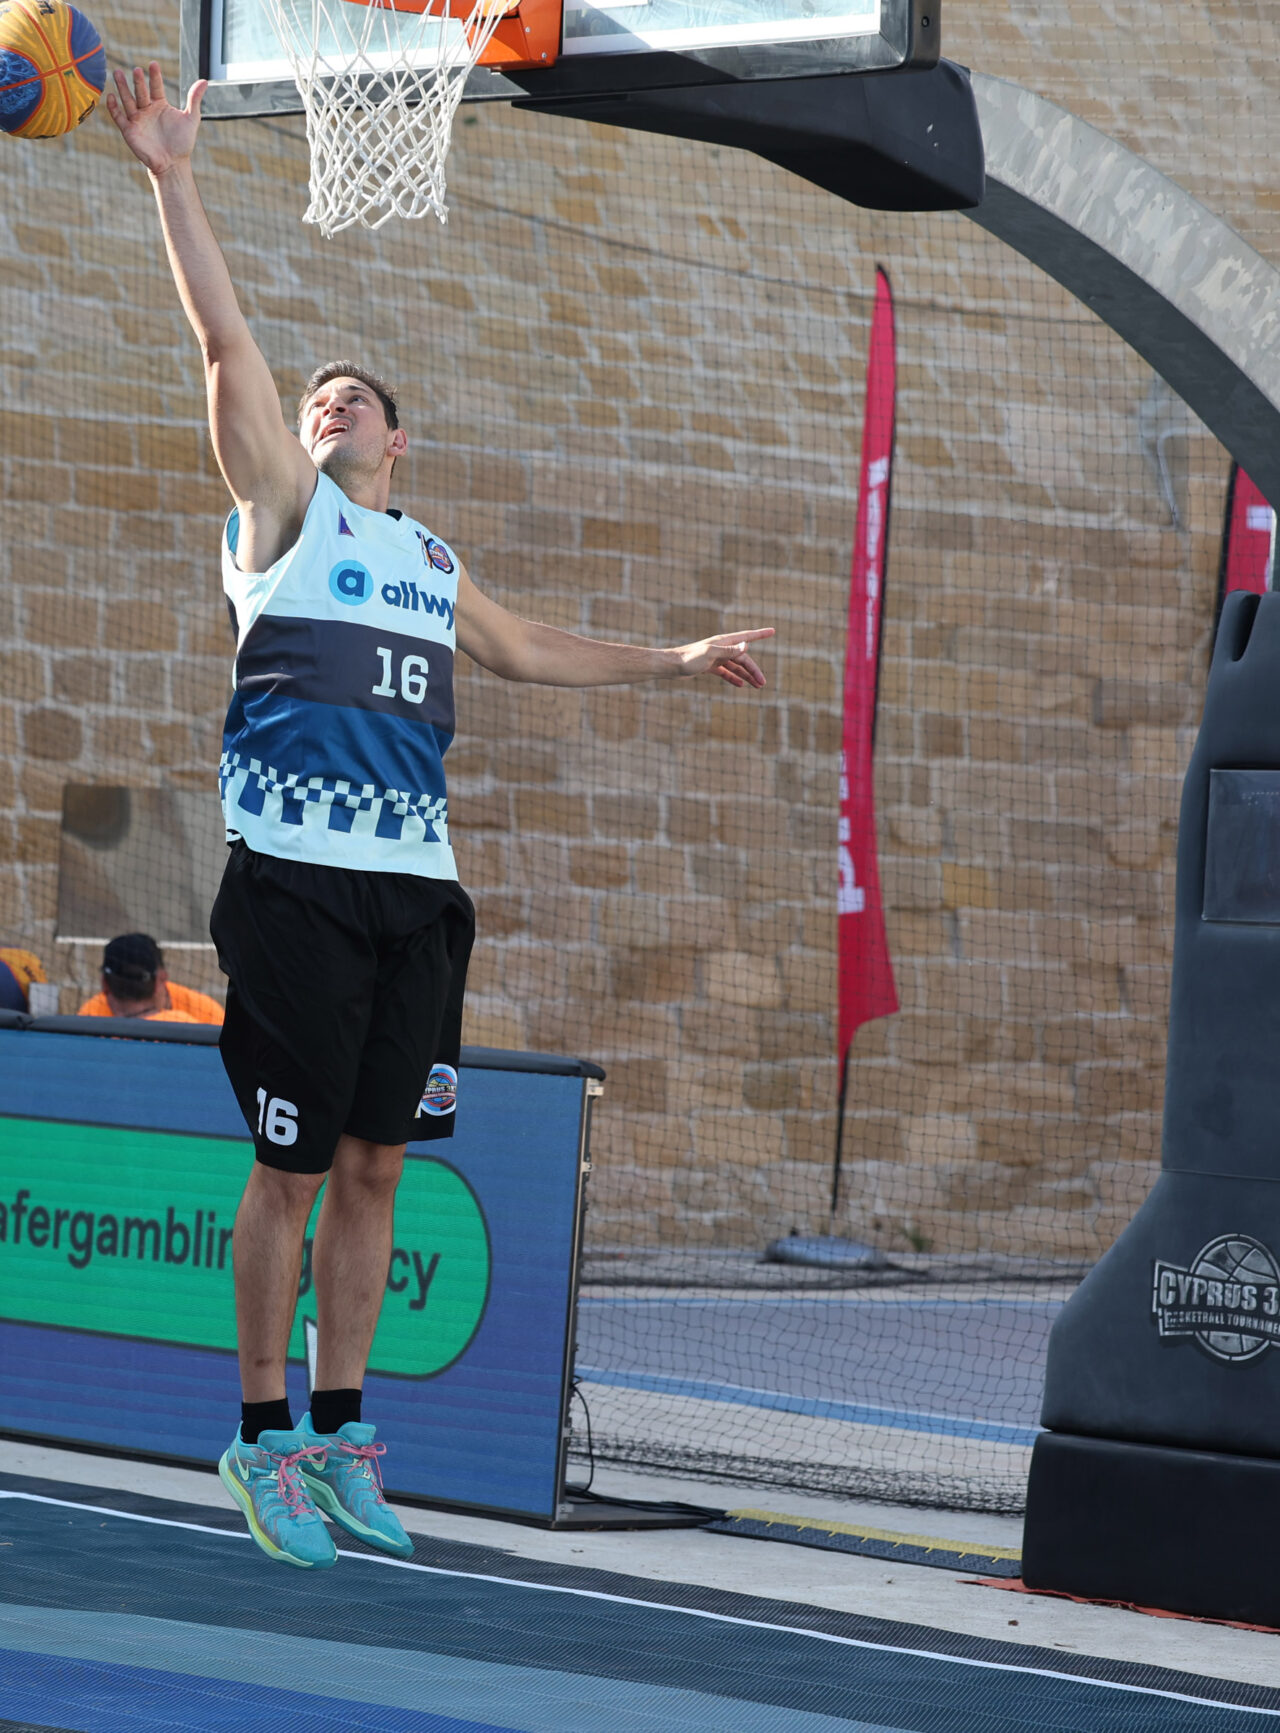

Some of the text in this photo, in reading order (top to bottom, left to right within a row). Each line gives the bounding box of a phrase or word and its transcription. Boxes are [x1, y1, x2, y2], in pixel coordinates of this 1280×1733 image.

[372, 646, 429, 704] 16
[256, 1087, 299, 1146] 16
[1160, 1270, 1258, 1311] CYPRUS
